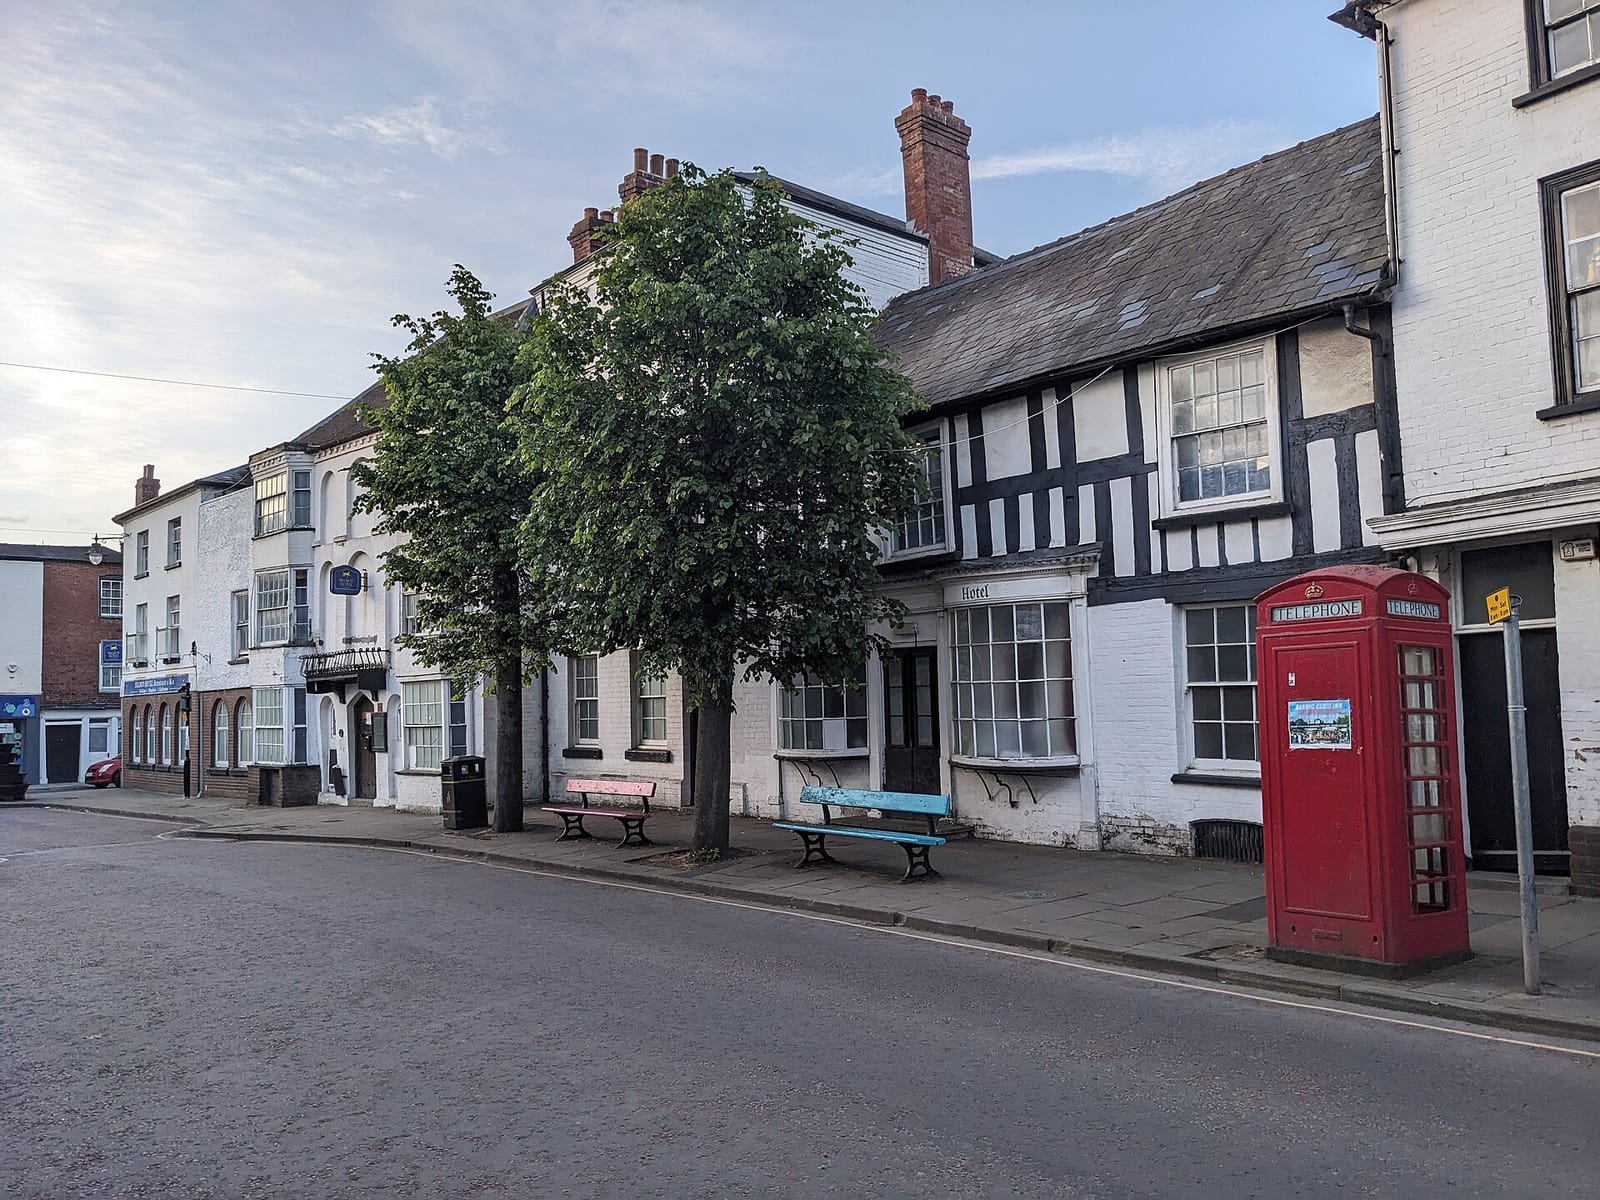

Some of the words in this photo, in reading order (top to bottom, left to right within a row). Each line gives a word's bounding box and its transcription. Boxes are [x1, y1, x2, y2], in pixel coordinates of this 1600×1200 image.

[962, 584, 989, 600] Hotel
[1277, 601, 1361, 620] TELEPHONE
[1388, 600, 1439, 617] TELEPHONE
